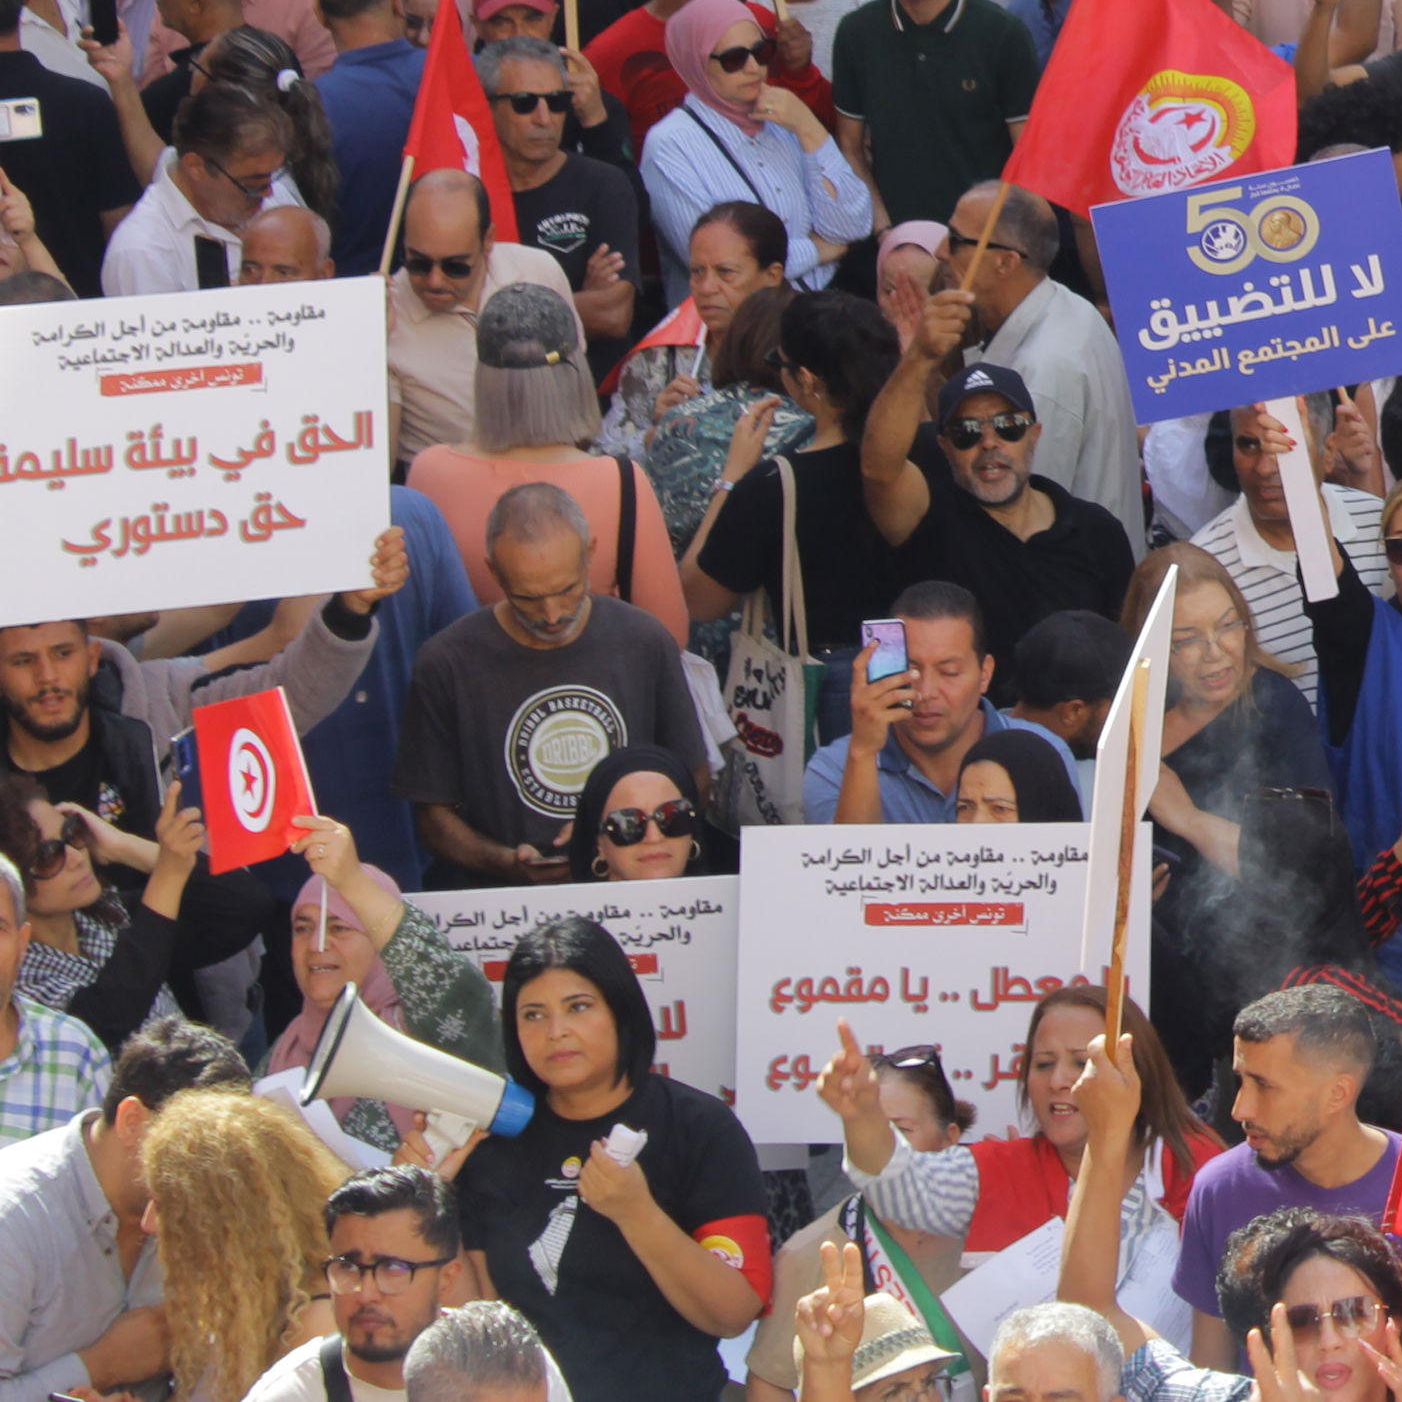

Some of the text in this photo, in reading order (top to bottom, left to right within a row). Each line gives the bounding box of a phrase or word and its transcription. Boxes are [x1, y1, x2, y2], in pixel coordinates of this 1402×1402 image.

[1185, 186, 1320, 276] 50
[1138, 253, 1386, 351] لا للتضييق
[32, 304, 326, 347] مقاومة مقاومة من أجل الكرامة
[58, 338, 223, 371] والعدالة الاجتماعية
[208, 367, 245, 387] تونس
[1146, 317, 1397, 394] على المجتمع المدني
[124, 422, 199, 479] بيئة
[208, 419, 277, 482] في
[287, 410, 374, 465] الحق
[61, 491, 307, 567] حق دستوري
[801, 844, 1089, 873] مقاومة مقاومة من أجل الكرامة
[825, 874, 986, 897] والعدالة الاجتماعية
[492, 905, 529, 930] أجل
[658, 899, 724, 919] مقاومة
[882, 908, 929, 923] ممكنة
[969, 906, 1007, 922] تونس
[770, 966, 891, 1014] مقموع
[900, 967, 930, 1014] يا
